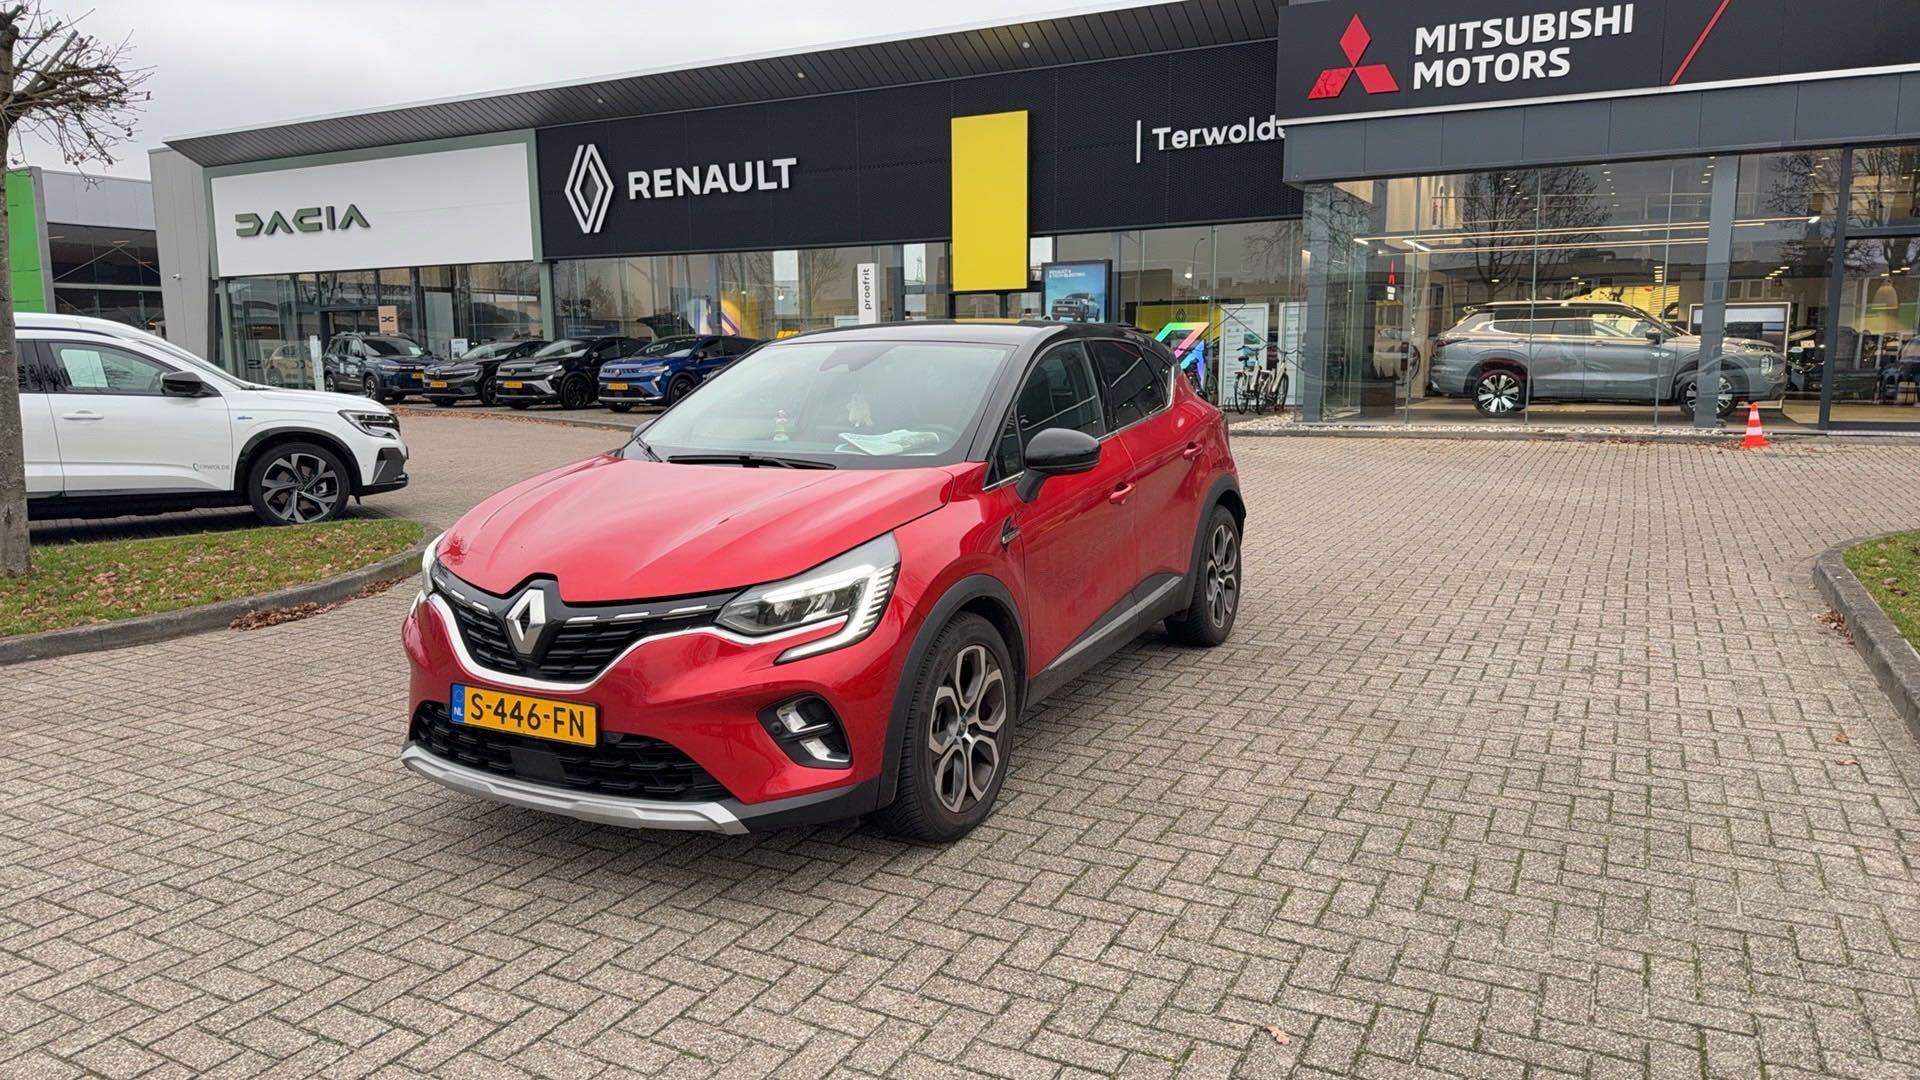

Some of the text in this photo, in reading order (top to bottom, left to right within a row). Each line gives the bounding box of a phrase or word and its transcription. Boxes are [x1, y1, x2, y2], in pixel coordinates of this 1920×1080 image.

[1414, 3, 1634, 56] MITSUBISHI
[1413, 47, 1570, 90] MOTORS
[627, 157, 797, 200] RENAULT
[234, 203, 371, 237] DACIA
[453, 706, 463, 716] NL
[470, 693, 585, 738] S-446-FN
